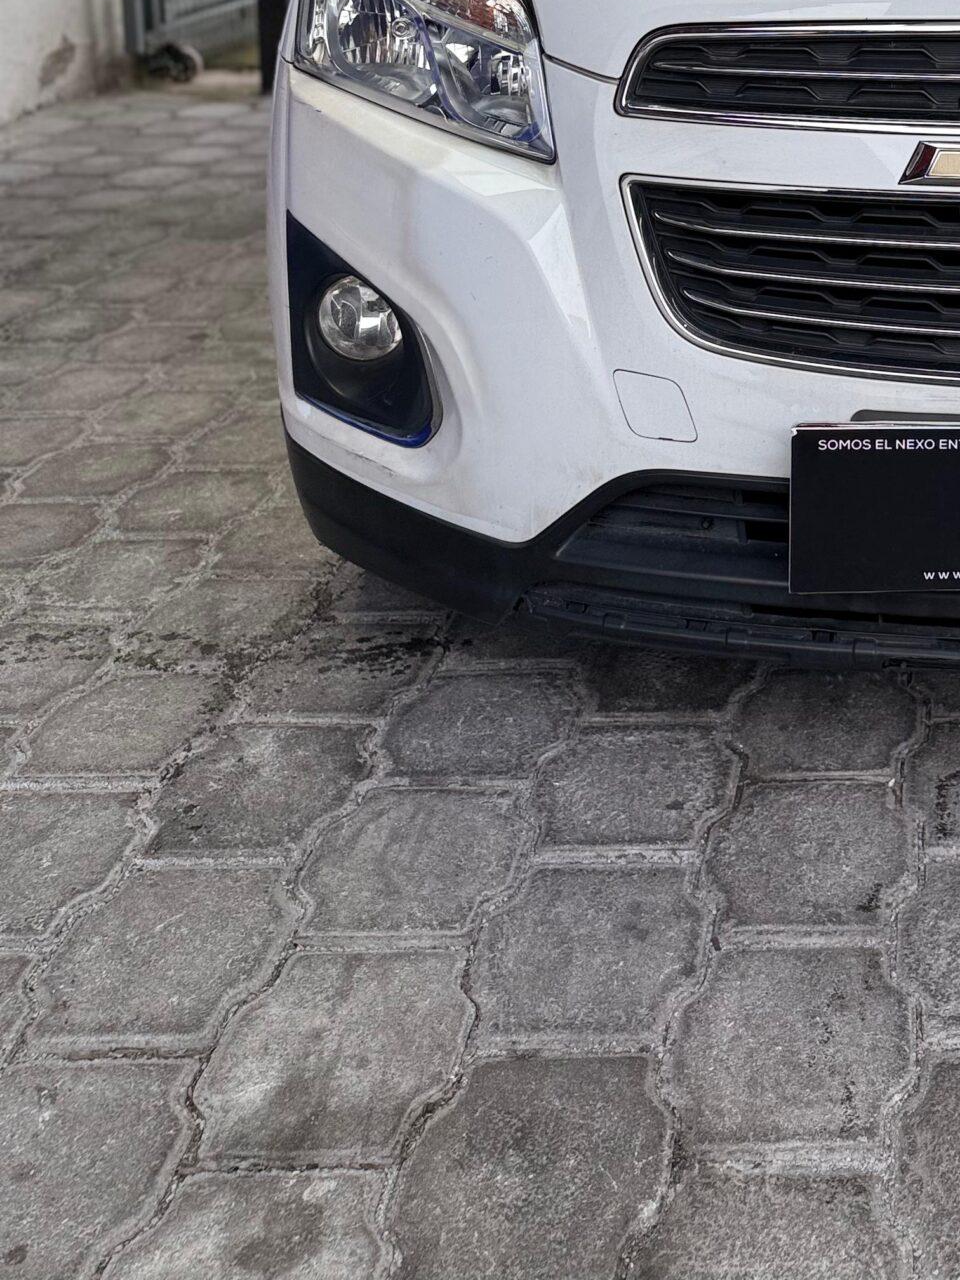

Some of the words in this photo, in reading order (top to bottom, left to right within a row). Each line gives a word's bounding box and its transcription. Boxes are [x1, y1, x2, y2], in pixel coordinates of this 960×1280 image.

[817, 438, 872, 451] SOMOS
[875, 438, 893, 450] EL
[895, 438, 936, 450] NEXO
